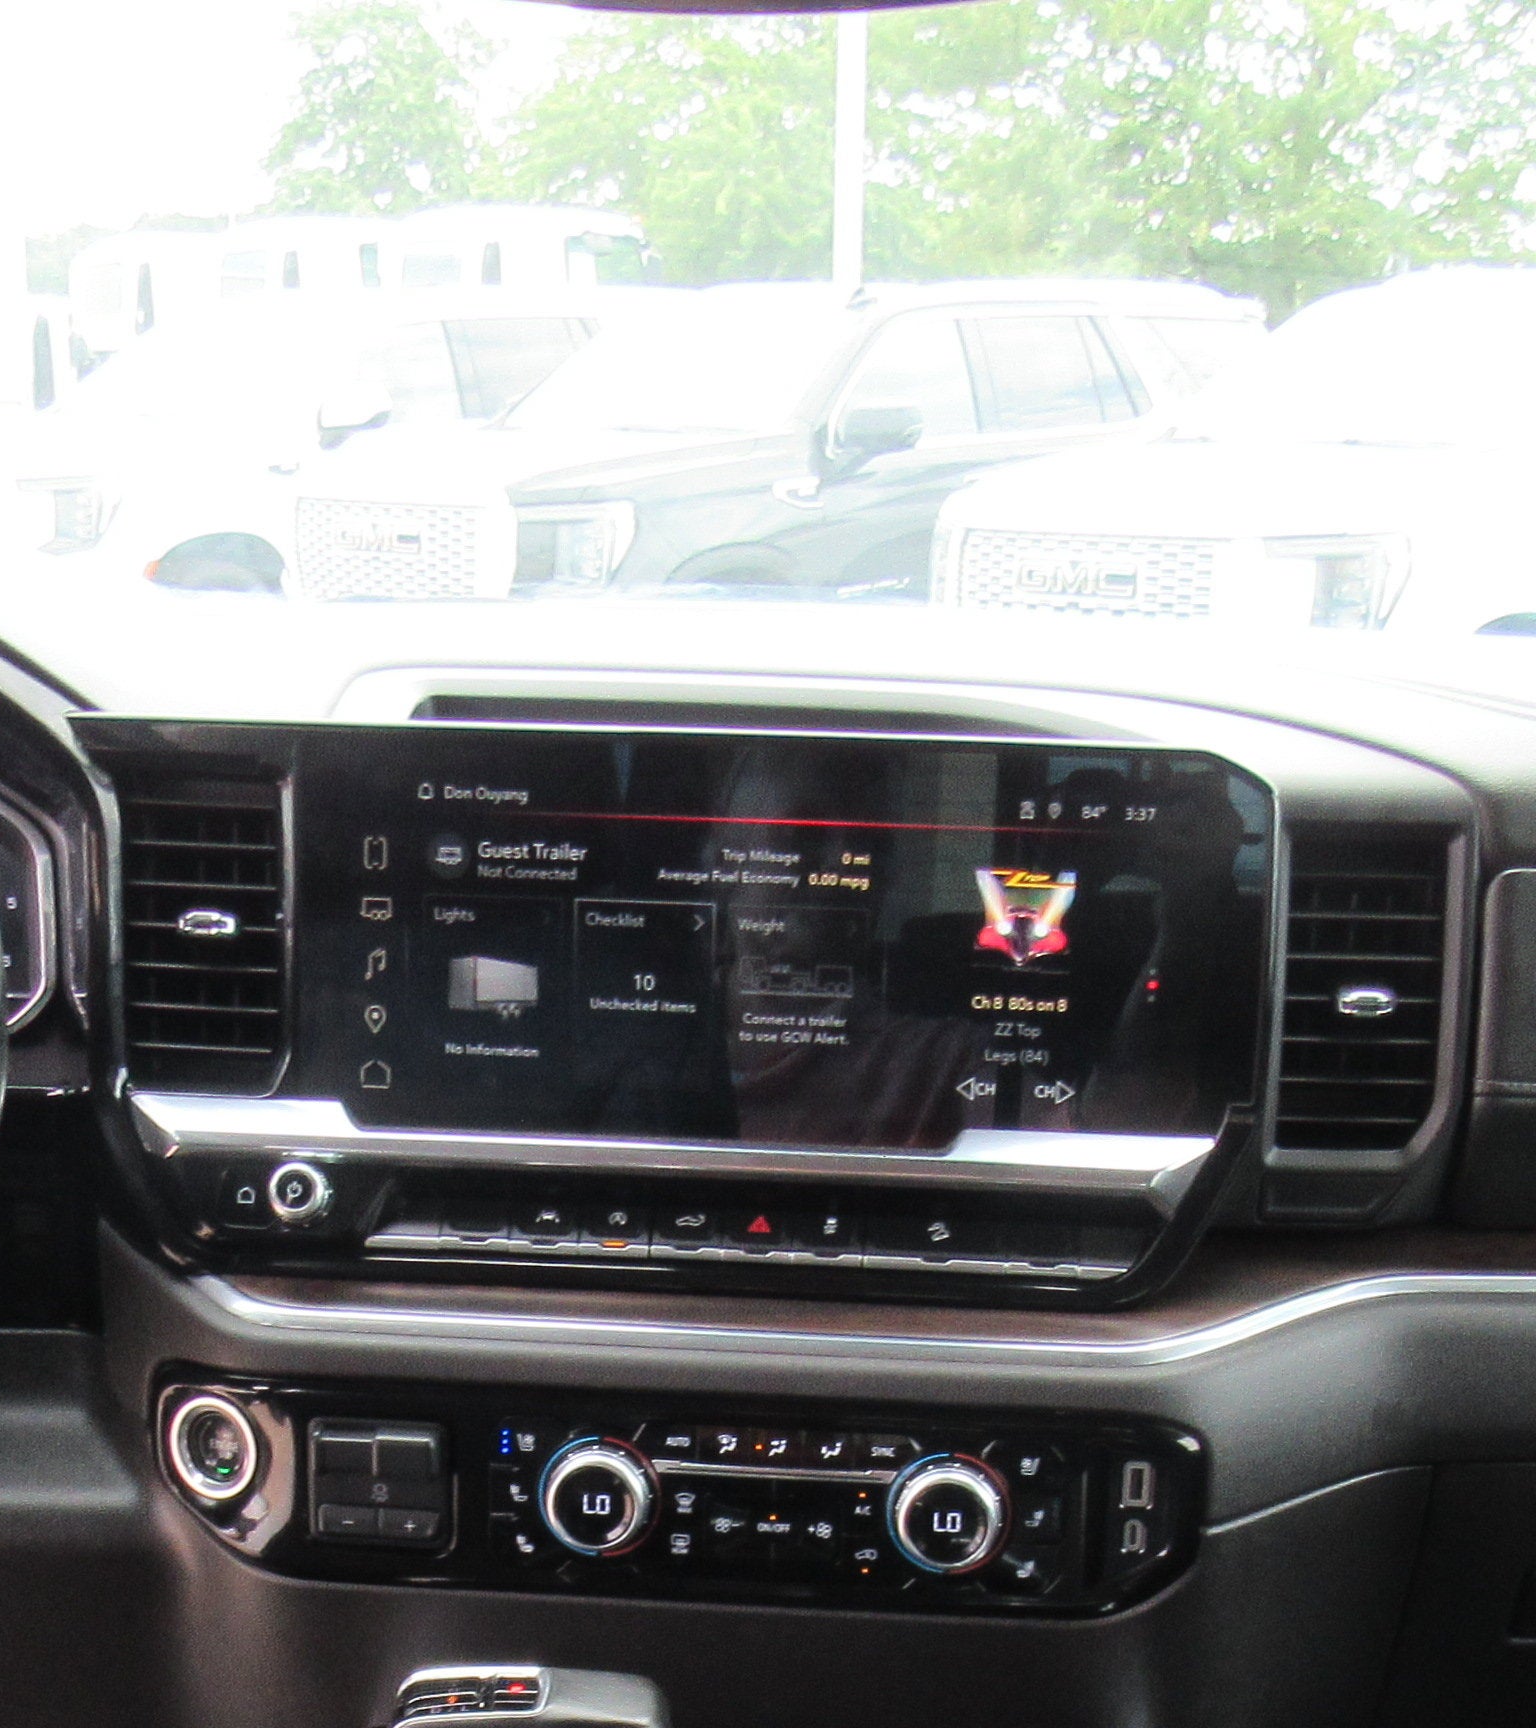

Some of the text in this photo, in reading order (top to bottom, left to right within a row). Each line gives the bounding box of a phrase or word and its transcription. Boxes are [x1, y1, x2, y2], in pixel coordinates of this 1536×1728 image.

[1016, 558, 1139, 599] GMC
[443, 785, 473, 800] Don
[1124, 807, 1157, 822] 3:37
[477, 841, 588, 862] Guest Trailer
[477, 864, 578, 881] Not Connected
[839, 874, 871, 892] mpg
[433, 906, 476, 926] Lights
[584, 911, 647, 929] Checklist
[632, 973, 656, 992] 10
[589, 996, 659, 1013] Unchecked
[971, 995, 1068, 1013] Ch 8 80s on 8
[743, 1012, 795, 1026] Connect
[994, 1022, 1042, 1040] ZZ Top
[445, 1042, 541, 1058] No Information
[984, 1049, 1017, 1066] Legs
[974, 1082, 997, 1097] CH
[1034, 1084, 1056, 1099] CH
[756, 1522, 791, 1534] ON/OFF
